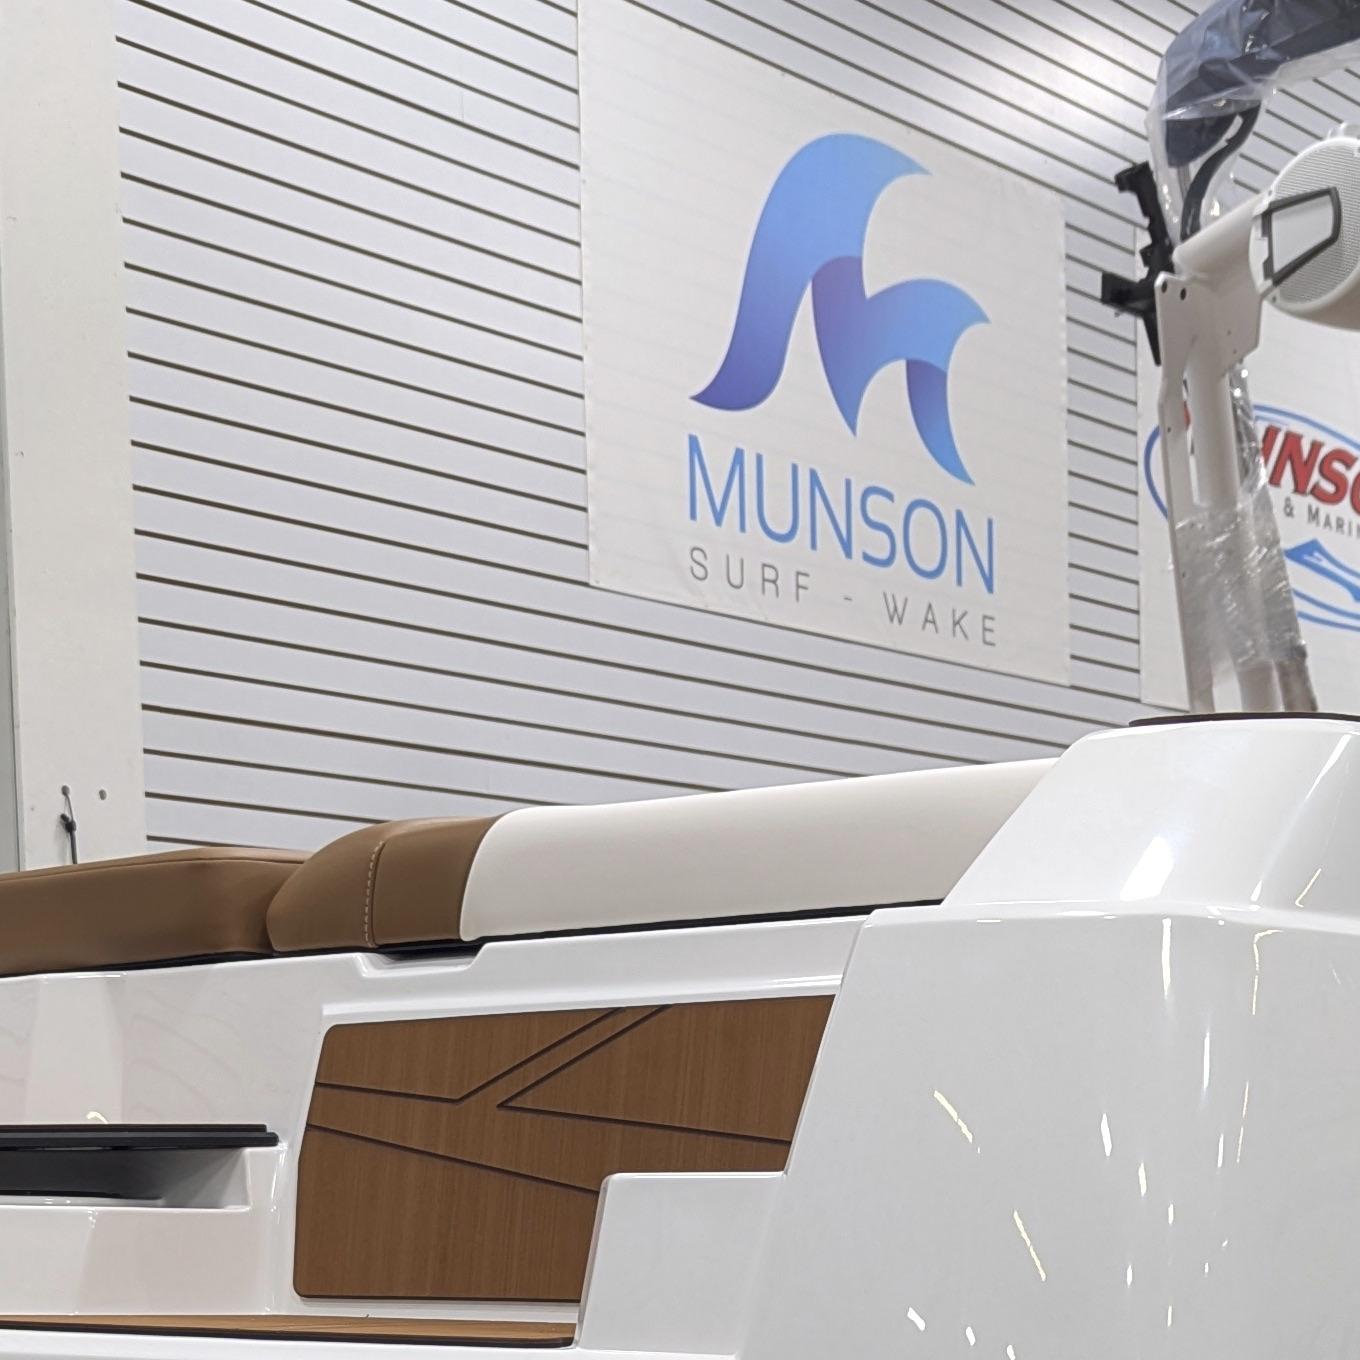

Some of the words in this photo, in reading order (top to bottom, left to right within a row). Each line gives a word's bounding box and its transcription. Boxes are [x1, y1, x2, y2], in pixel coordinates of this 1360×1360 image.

[688, 433, 994, 595] MUNSON
[689, 546, 810, 603] SURF
[883, 591, 996, 647] WAKE
